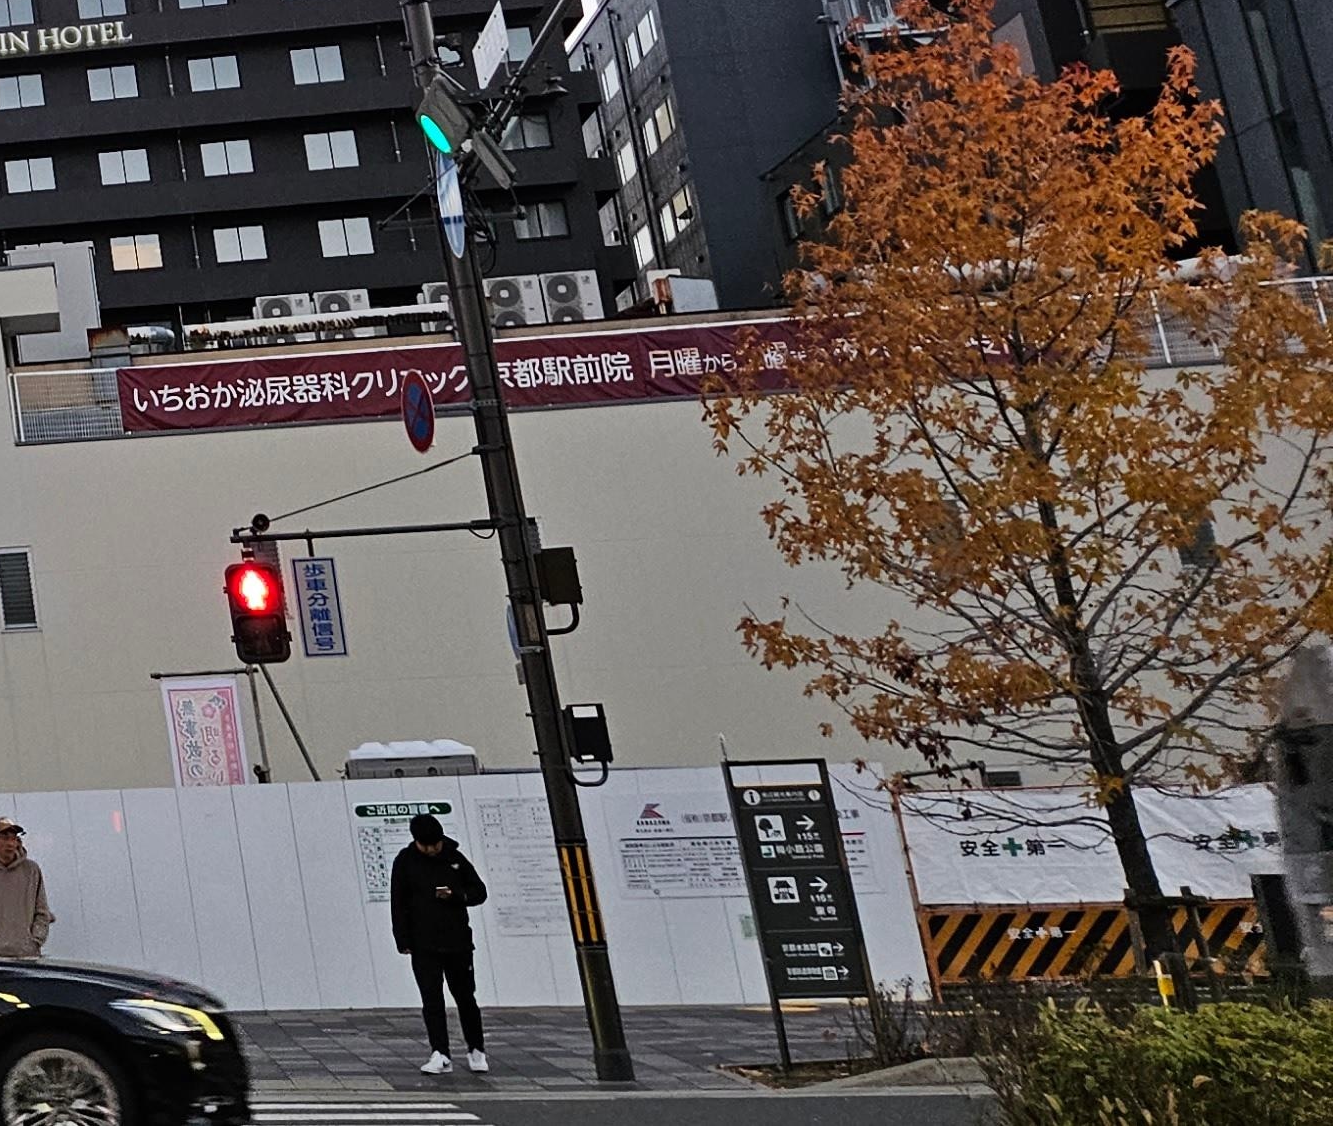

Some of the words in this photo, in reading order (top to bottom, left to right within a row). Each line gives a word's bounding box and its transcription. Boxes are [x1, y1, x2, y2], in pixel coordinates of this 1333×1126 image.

[37, 21, 133, 52] HOTEL
[133, 365, 468, 413] いちおか泌尿器科クリック
[302, 563, 335, 651] 歩車分離信号
